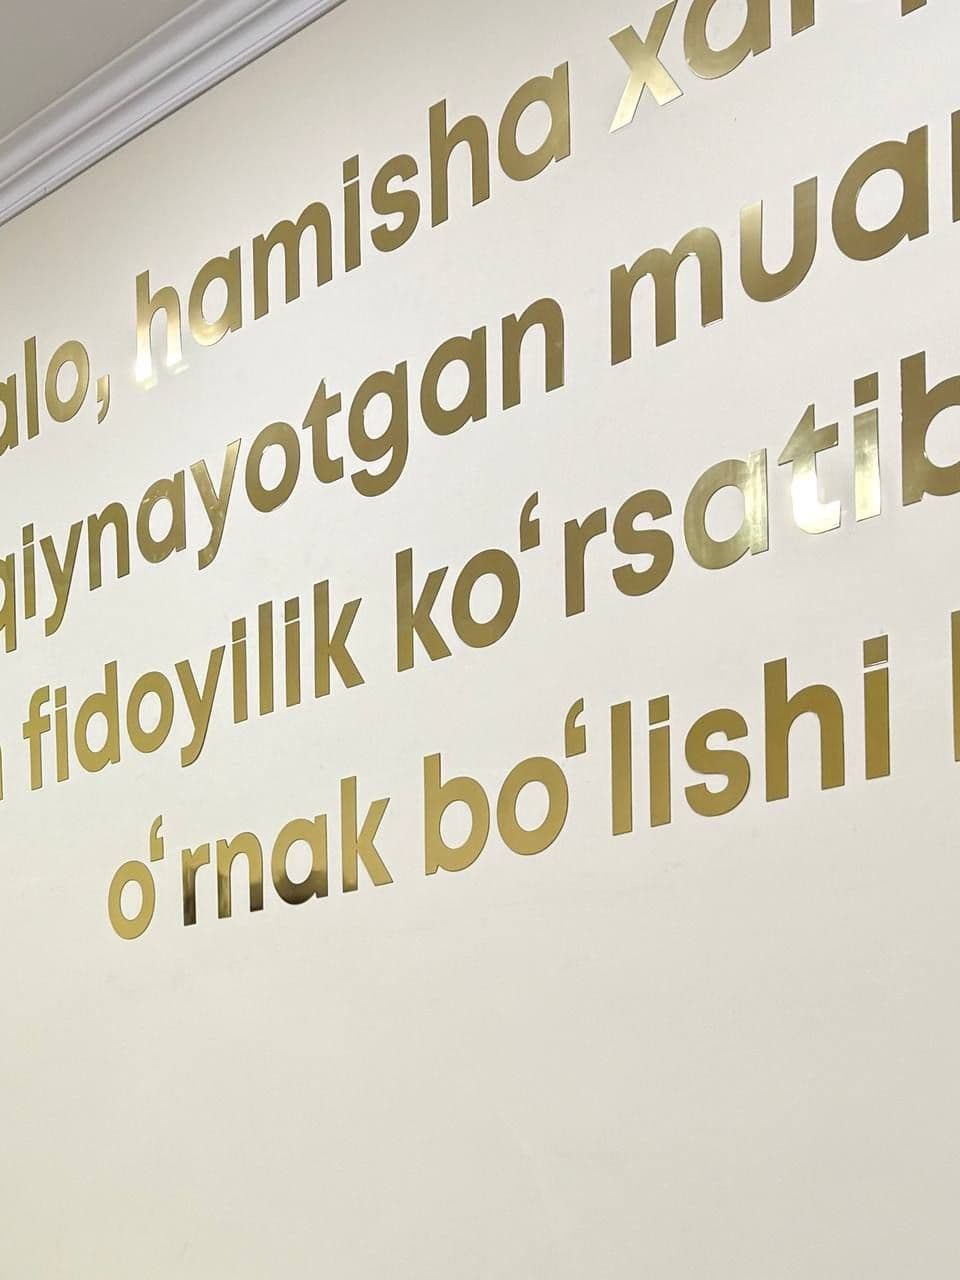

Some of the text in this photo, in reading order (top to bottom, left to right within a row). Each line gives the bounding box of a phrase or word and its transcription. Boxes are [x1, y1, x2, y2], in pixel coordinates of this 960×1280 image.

[135, 61, 572, 389] hamisha
[608, 0, 928, 133] xa
[609, 109, 960, 367] mua
[22, 578, 366, 791] fidoyilik
